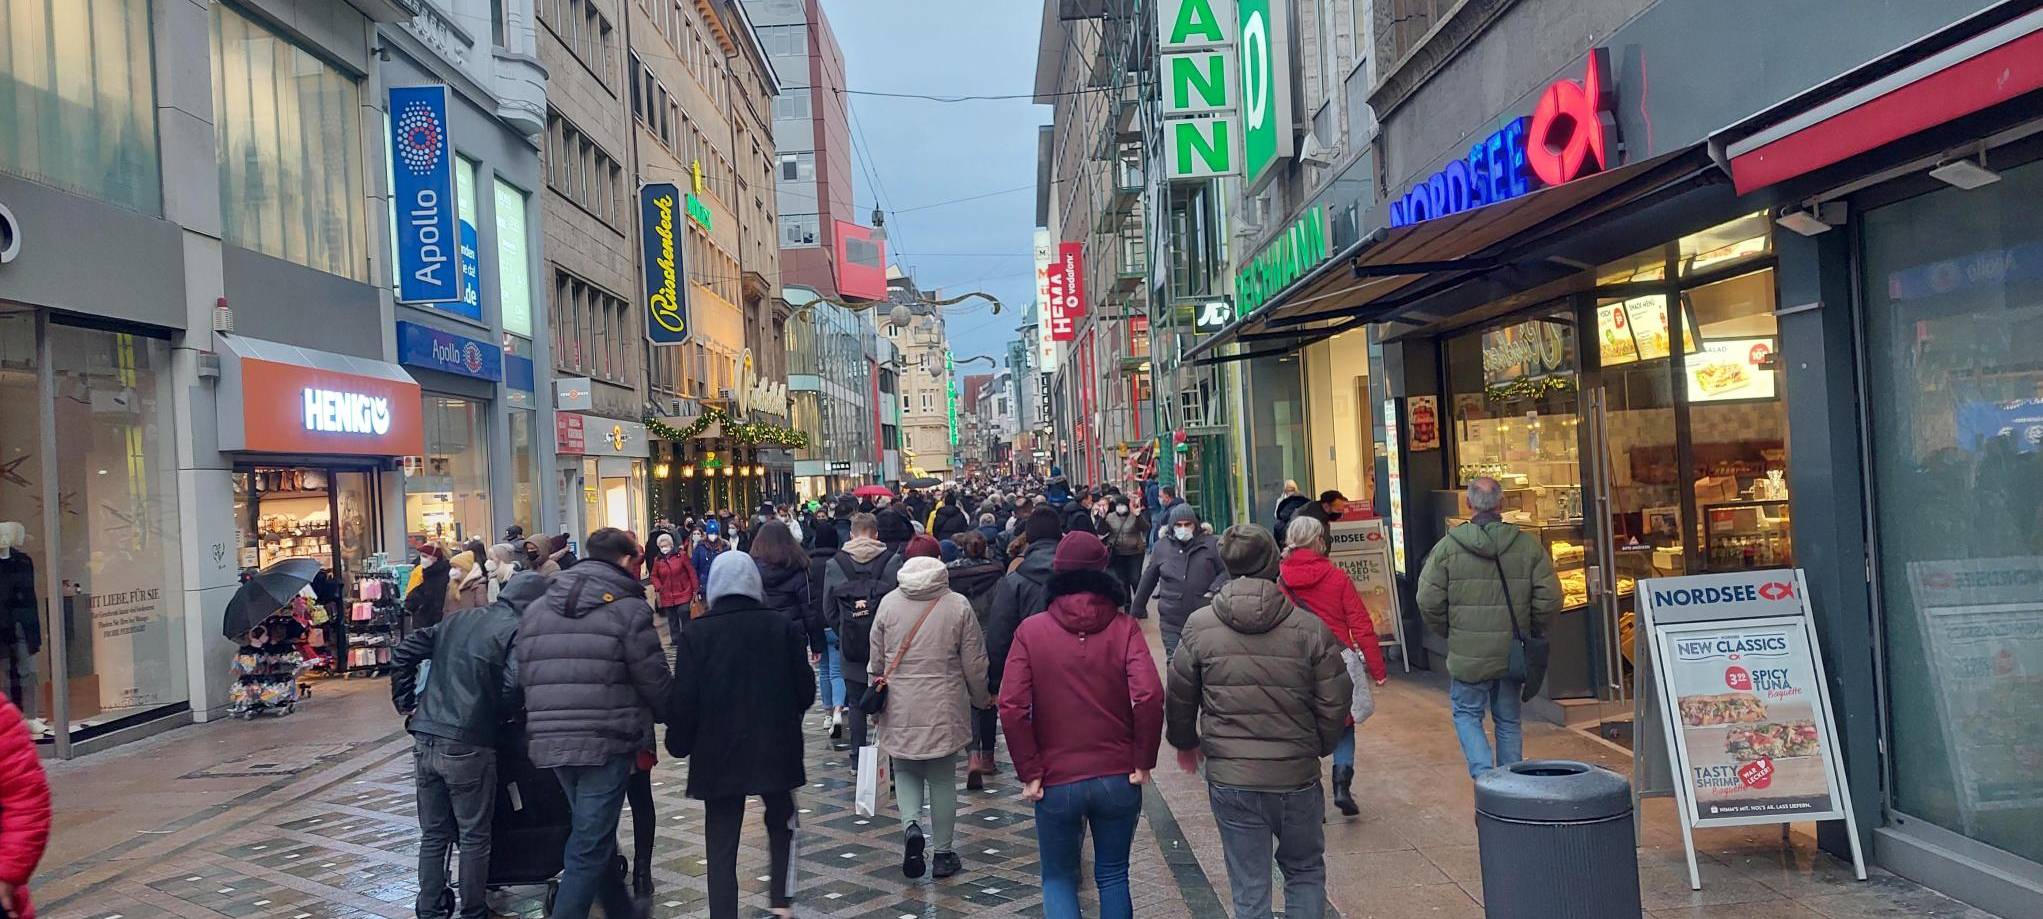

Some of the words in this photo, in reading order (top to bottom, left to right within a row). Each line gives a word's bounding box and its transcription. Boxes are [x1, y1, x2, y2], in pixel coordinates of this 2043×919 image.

[1390, 116, 1528, 227] NORDSEE
[411, 188, 447, 286] Apollo
[650, 194, 685, 332] Rüschenbeck
[463, 282, 478, 307] .de
[1197, 302, 1231, 327] JD
[432, 338, 461, 365] Apollo
[1330, 533, 1366, 545] ORDSEE
[1345, 567, 1369, 575] ASED
[1654, 584, 1757, 607] NORDSEE
[1677, 642, 1713, 656] NEW
[1716, 637, 1787, 653] CLASSICS
[1752, 668, 1788, 681] SPICY
[1753, 679, 1792, 692] TUNA
[1694, 765, 1738, 779] TASTY
[1742, 767, 1758, 779] WAR
[1697, 777, 1740, 788] SHRIMP
